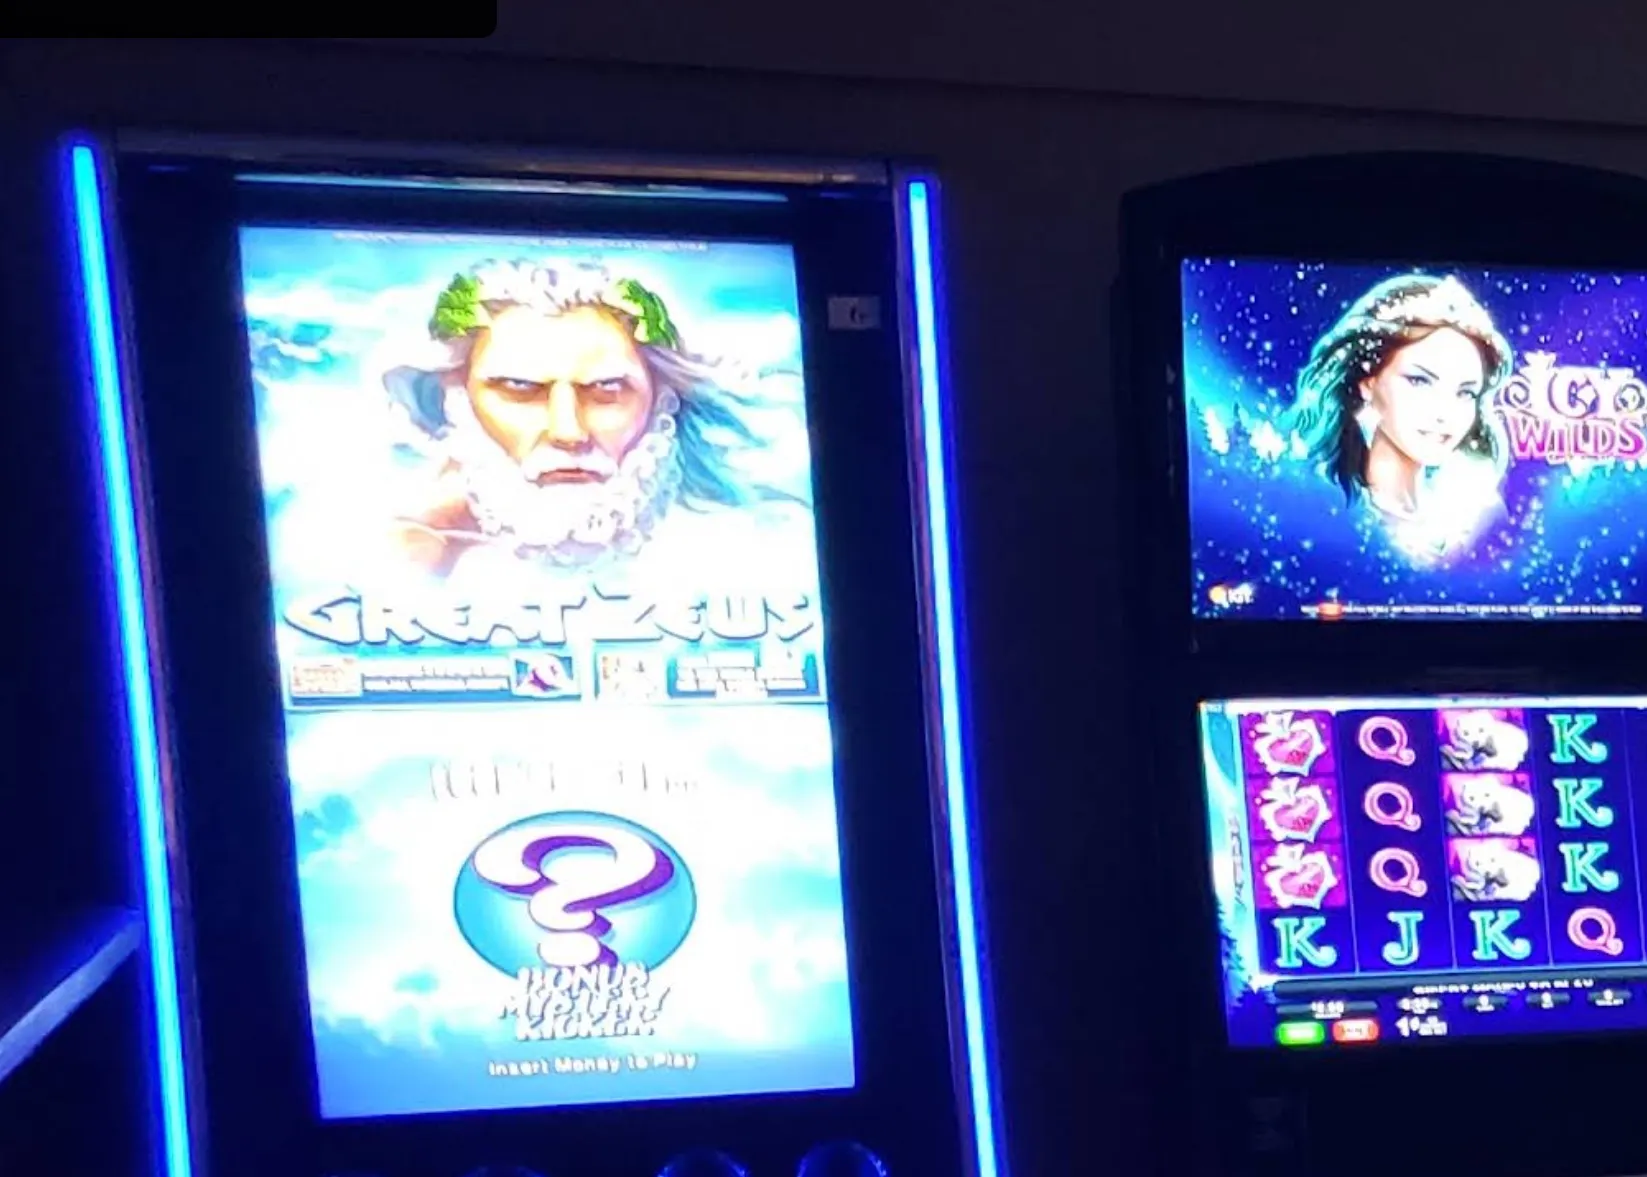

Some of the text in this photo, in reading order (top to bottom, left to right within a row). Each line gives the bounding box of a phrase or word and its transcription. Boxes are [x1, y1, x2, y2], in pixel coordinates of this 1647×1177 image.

[1509, 415, 1647, 460] WILDS
[1358, 715, 1416, 767] Q
[1547, 713, 1608, 764] K
[1364, 781, 1423, 832] Q
[1553, 777, 1614, 828] K
[1369, 847, 1427, 898] Q
[1559, 841, 1619, 893] K
[1273, 915, 1337, 969] K
[1383, 911, 1424, 966] J
[1469, 908, 1531, 962] K
[1567, 906, 1624, 957] Q
[488, 1052, 697, 1077] Insert Money to Play
